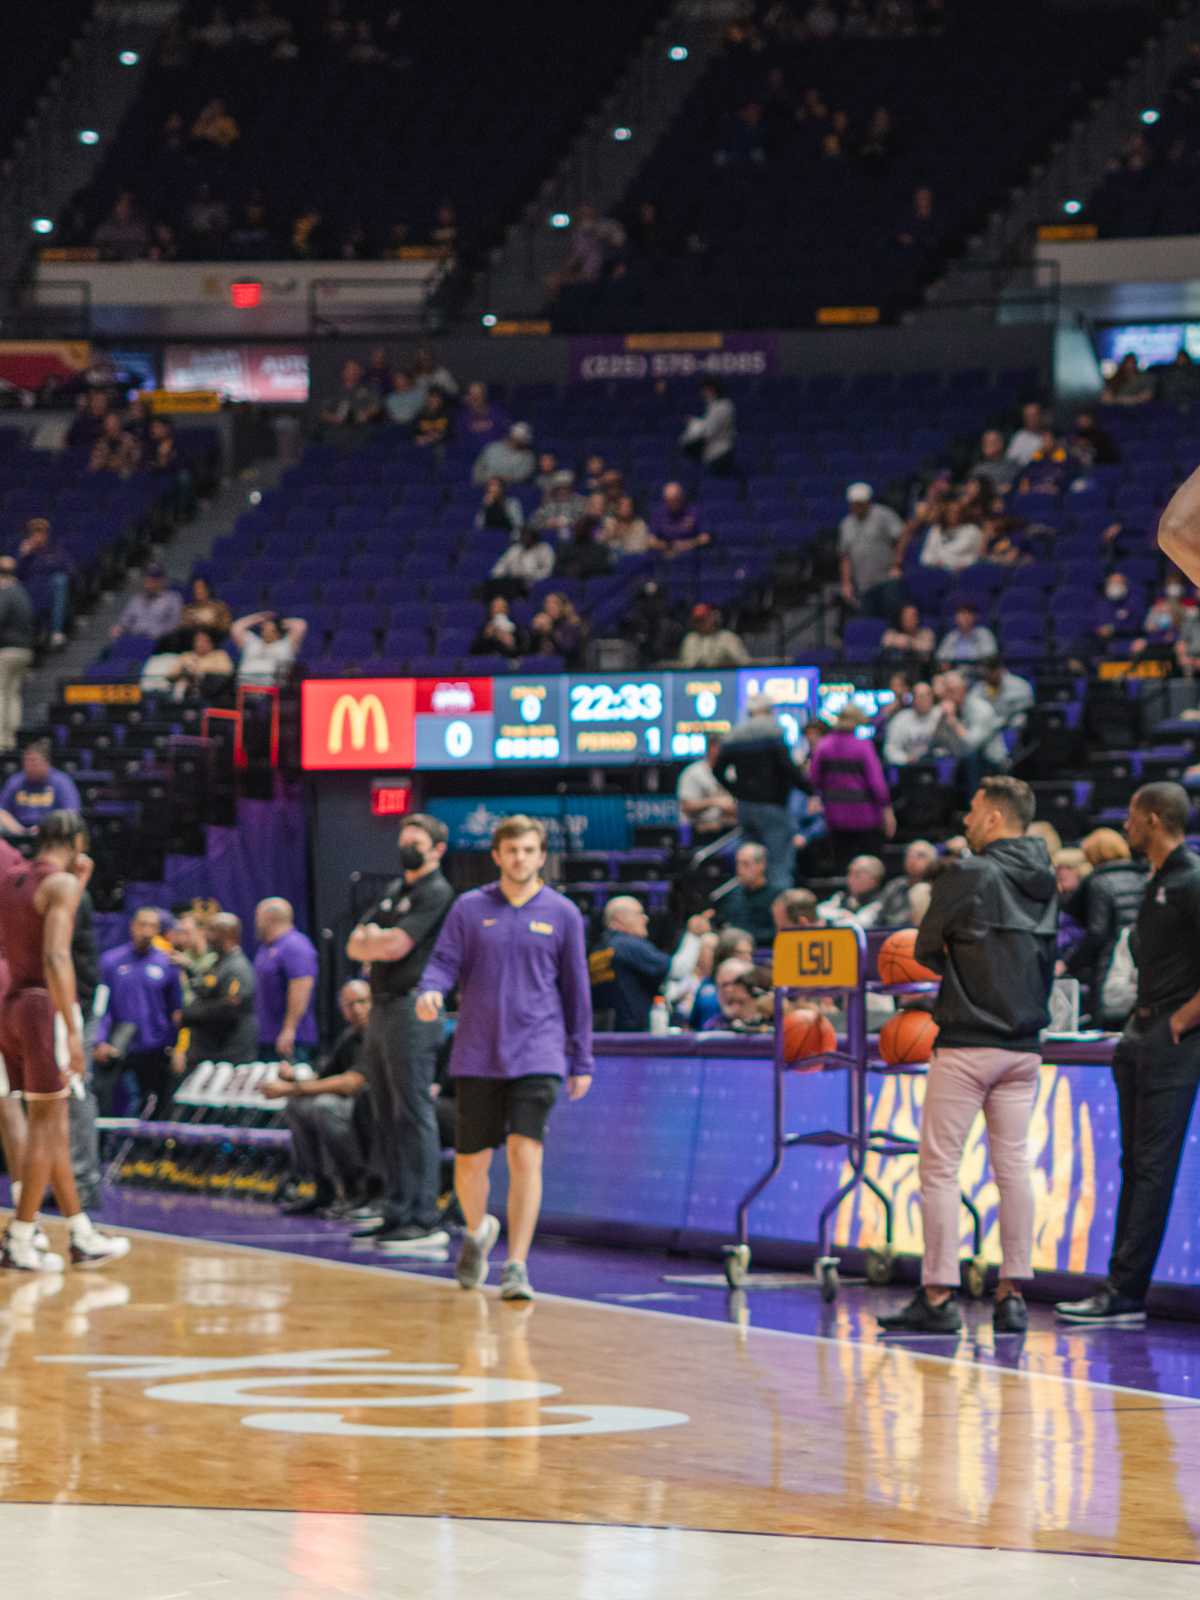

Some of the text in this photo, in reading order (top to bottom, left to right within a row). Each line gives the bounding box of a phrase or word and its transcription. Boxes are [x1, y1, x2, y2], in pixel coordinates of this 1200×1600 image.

[520, 695, 541, 723] 0
[570, 682, 663, 722] 22:33
[695, 690, 717, 718] 0
[444, 720, 473, 758] 0
[644, 726, 662, 756] 1
[797, 941, 833, 976] LSU
